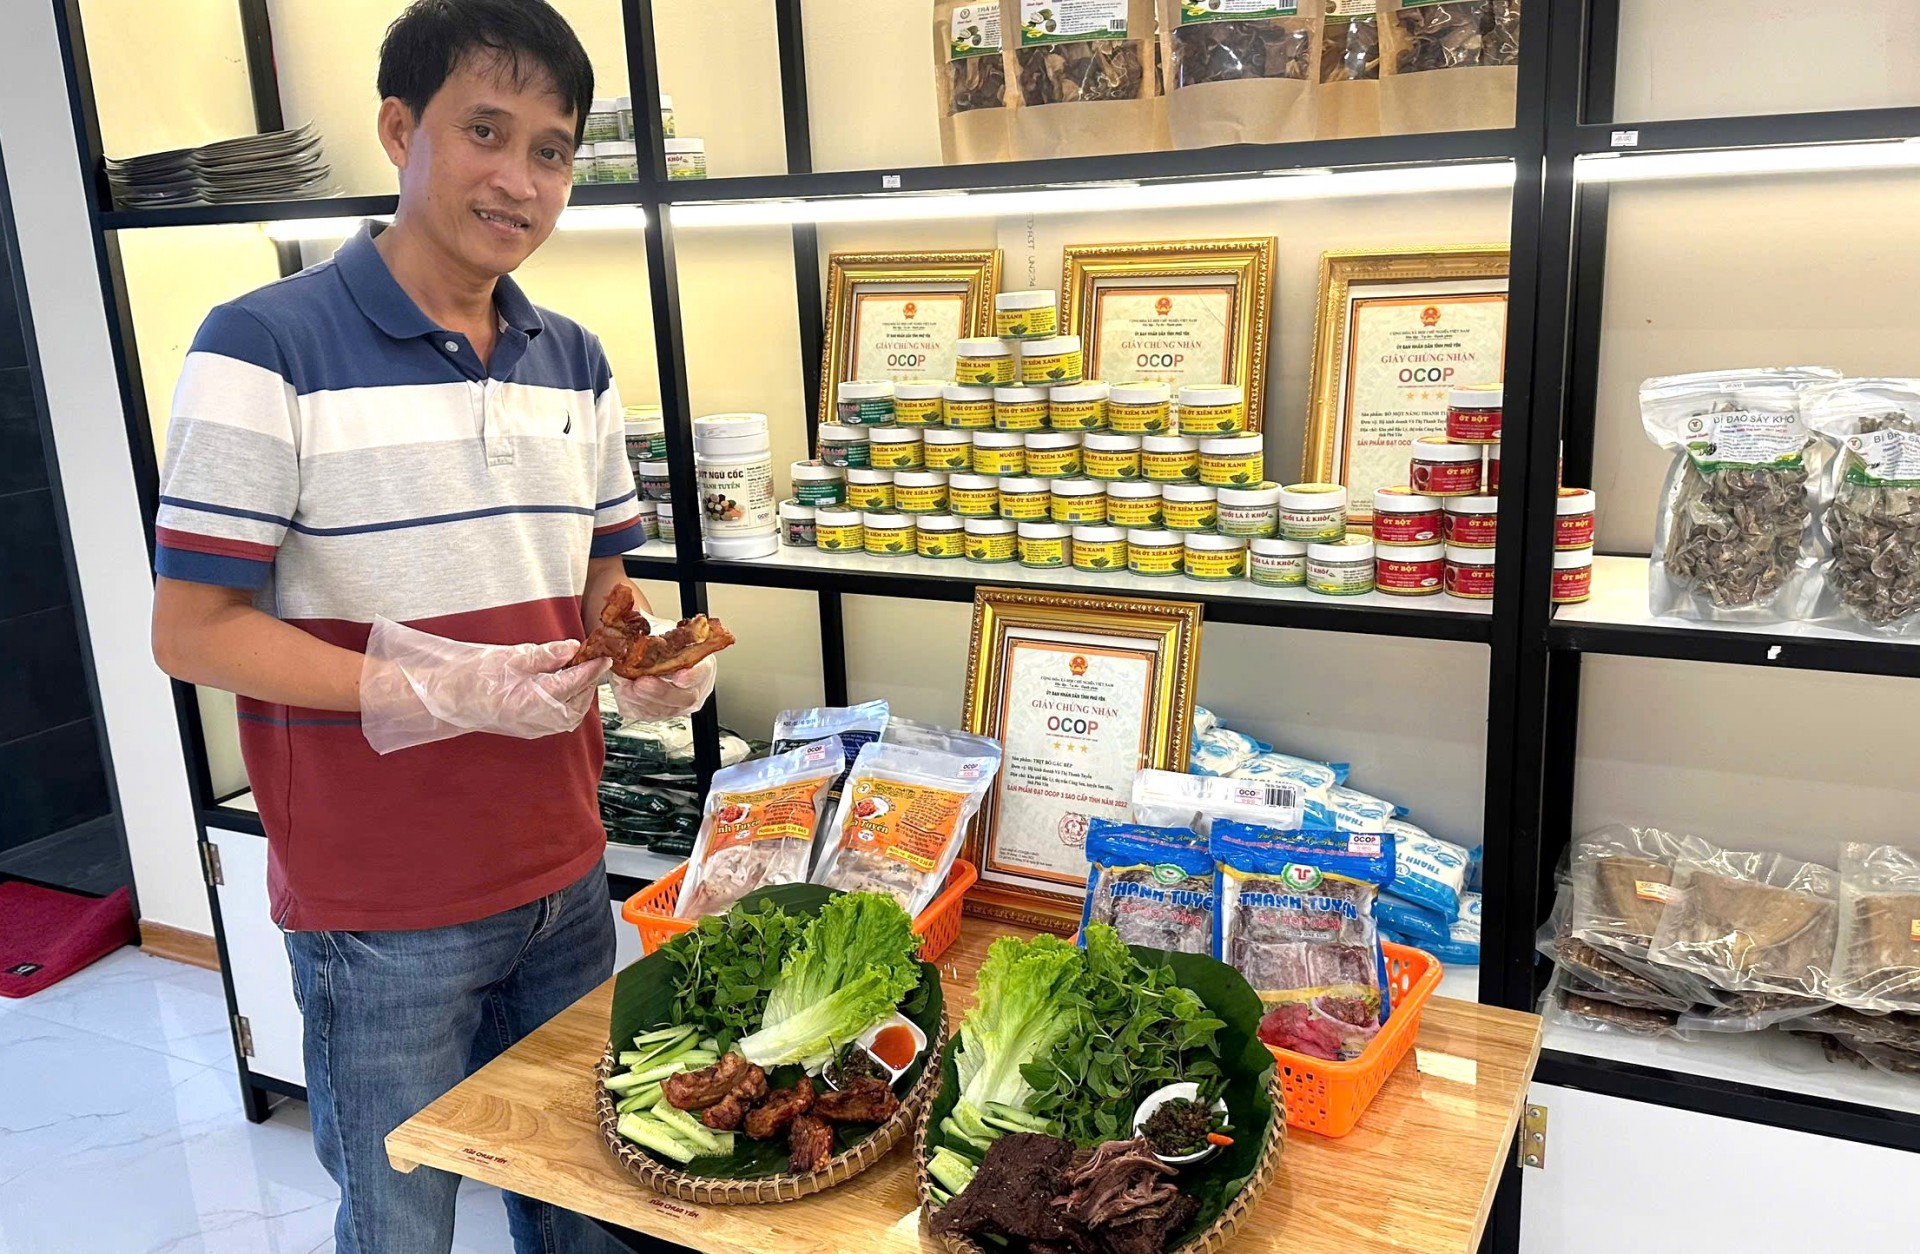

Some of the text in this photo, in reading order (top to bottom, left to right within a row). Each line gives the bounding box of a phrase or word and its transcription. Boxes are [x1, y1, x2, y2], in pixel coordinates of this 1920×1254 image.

[888, 354, 926, 366] OCOP
[1137, 354, 1184, 367] OCOP
[1399, 368, 1455, 382] OCOP
[1032, 700, 1118, 718] GIẤY CHỨNG NHẬN
[1047, 716, 1099, 735] OCOP
[1109, 882, 1165, 902] THANH
[1239, 892, 1302, 910] THANH
